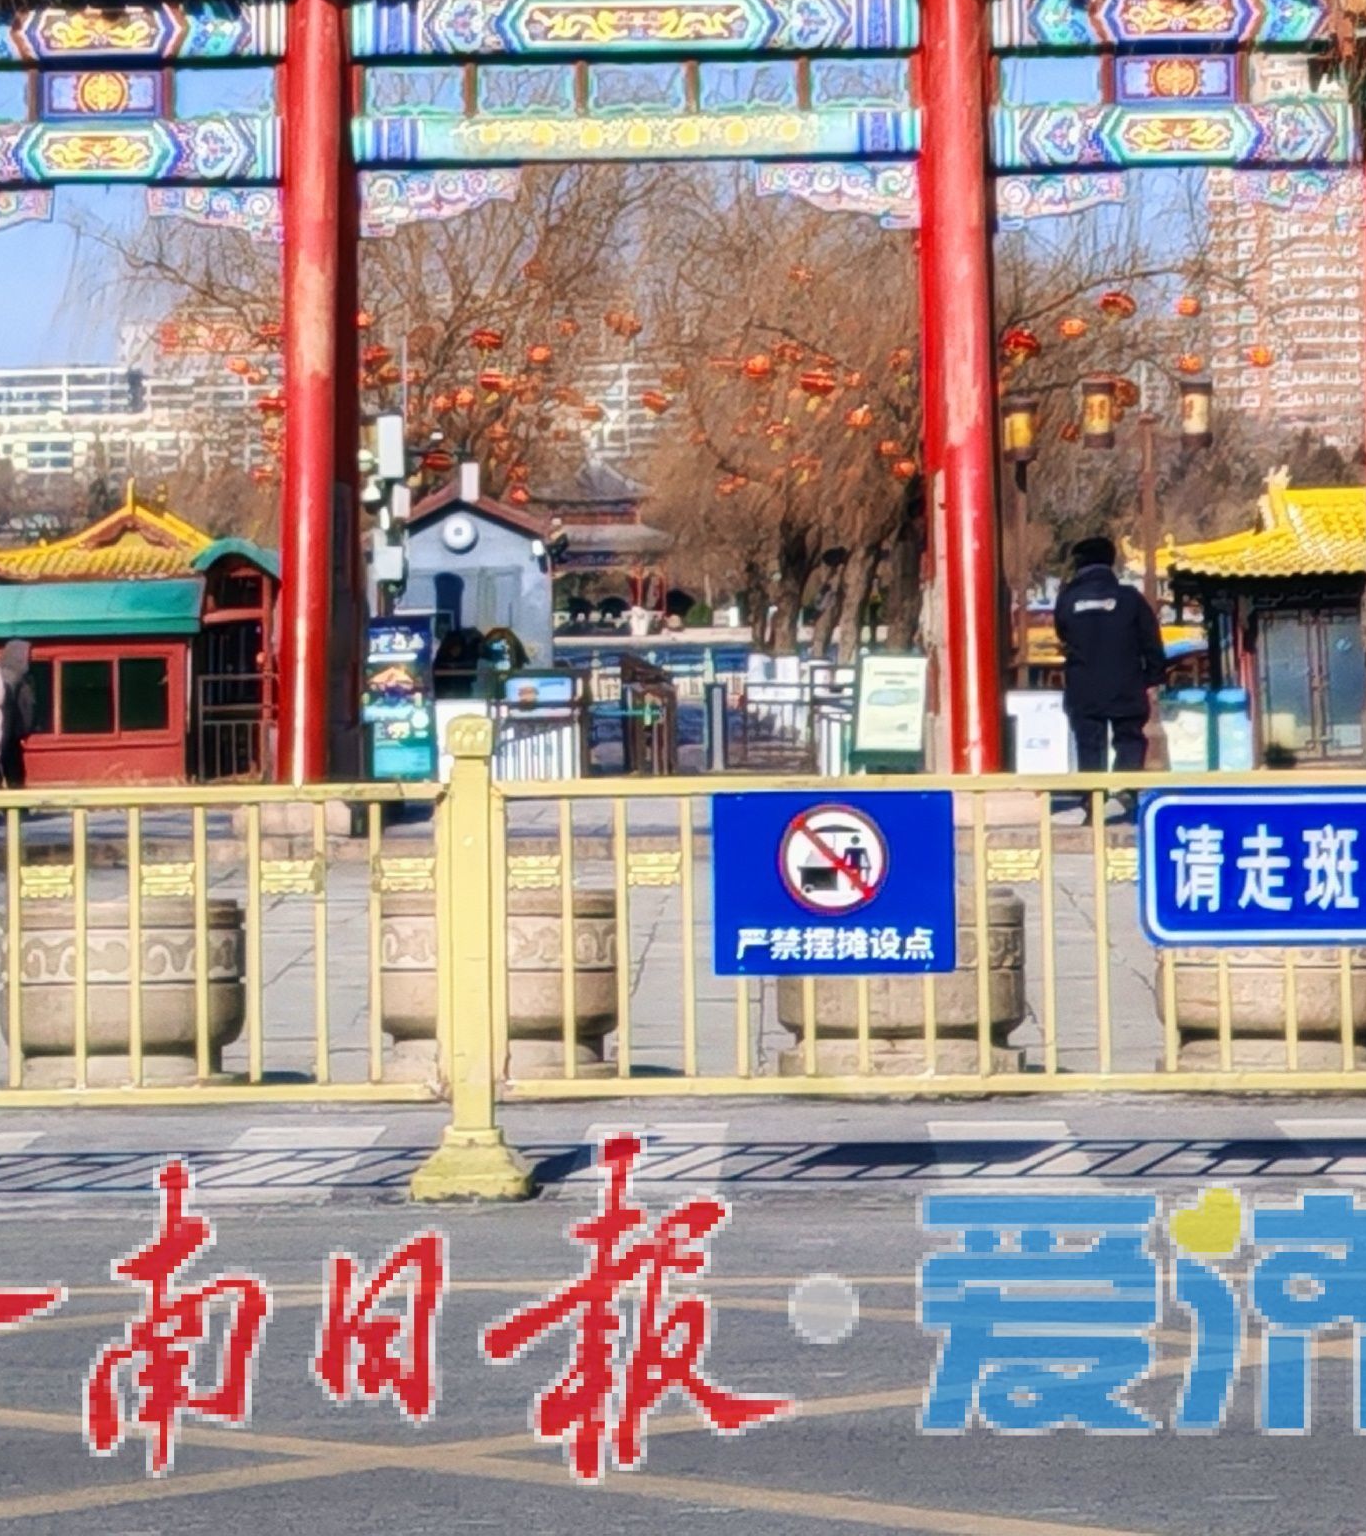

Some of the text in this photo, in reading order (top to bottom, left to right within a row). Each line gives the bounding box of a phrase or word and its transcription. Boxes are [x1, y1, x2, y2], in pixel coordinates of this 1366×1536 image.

[736, 927, 935, 961] 严禁摆摊设点
